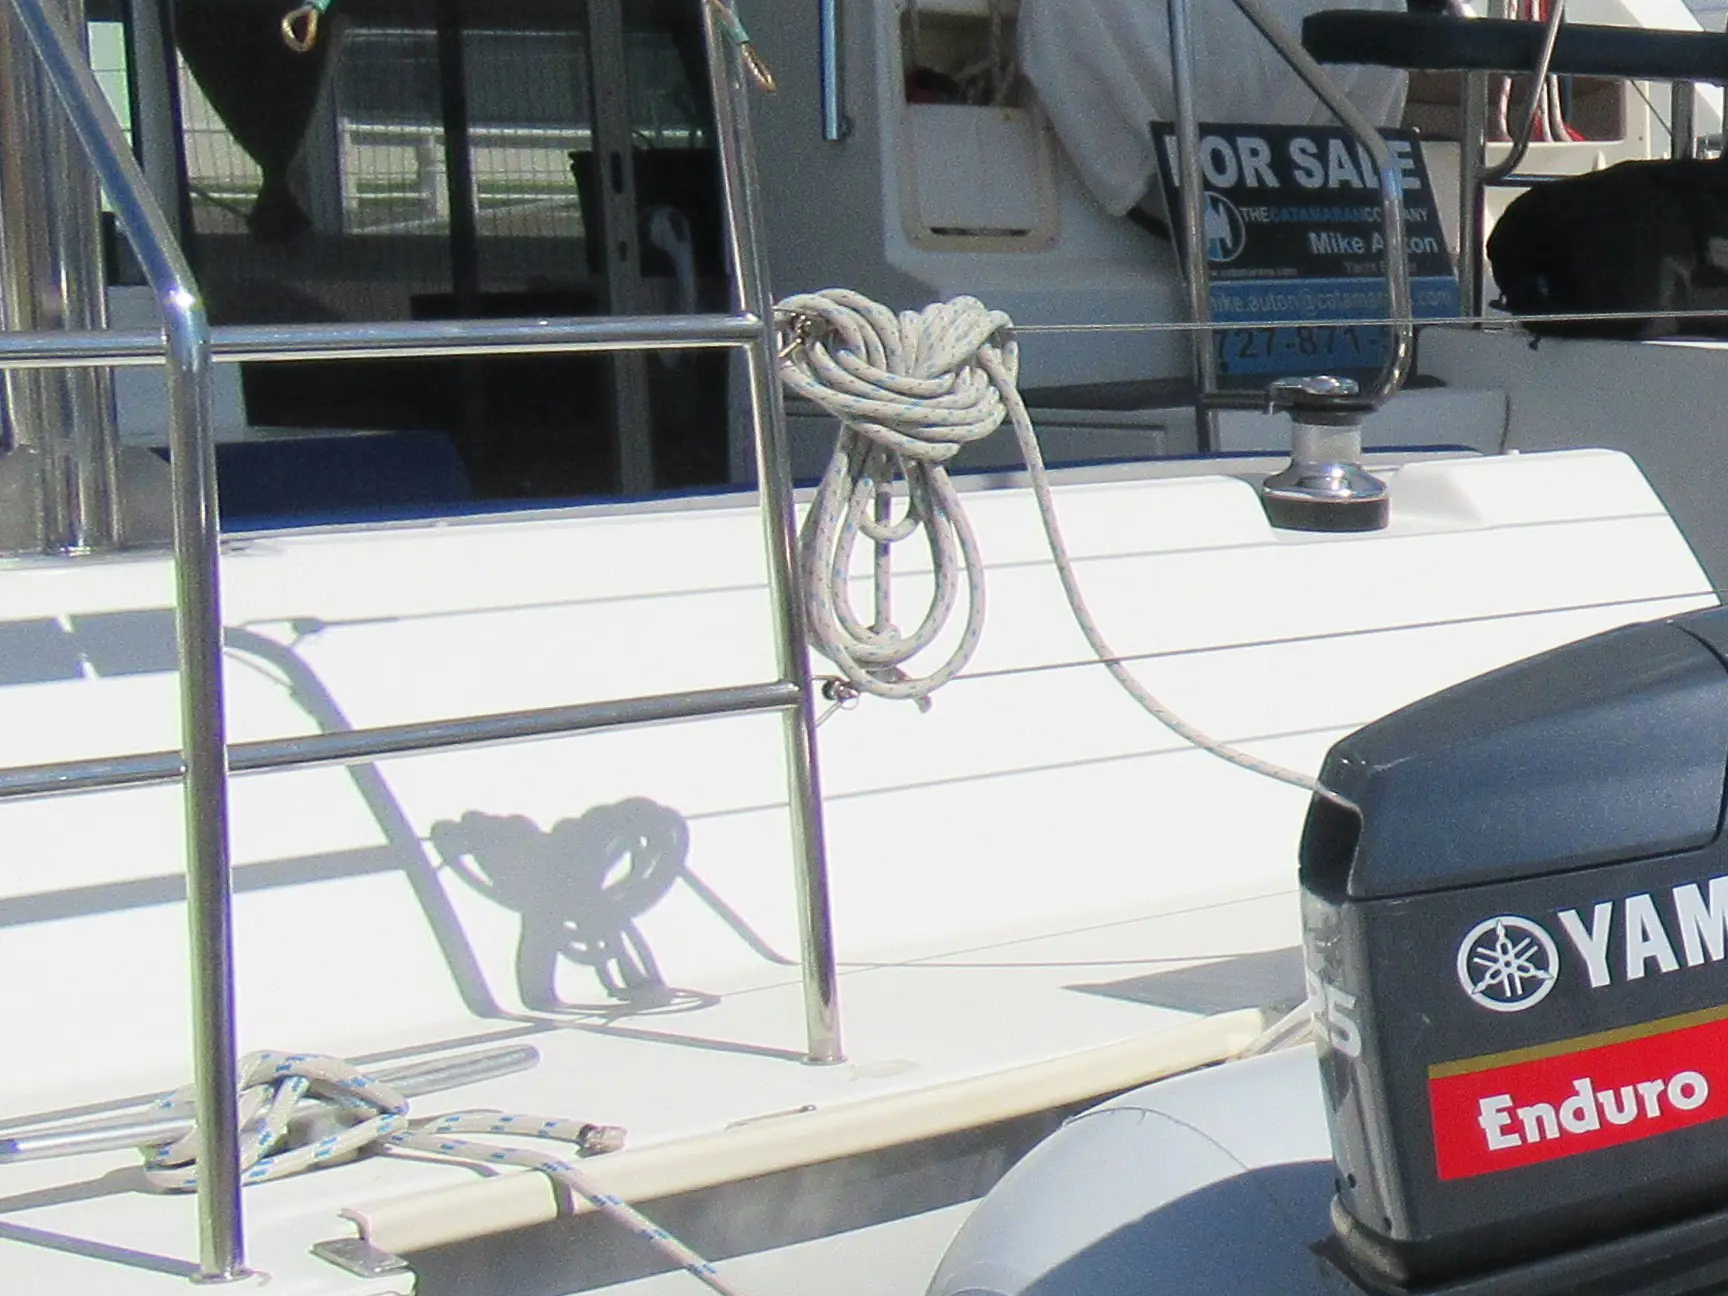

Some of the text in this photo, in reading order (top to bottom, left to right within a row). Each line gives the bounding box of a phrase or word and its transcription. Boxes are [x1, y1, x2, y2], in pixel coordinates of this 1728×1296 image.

[1287, 137, 1421, 190] SALE
[1308, 231, 1439, 254] Mike Aon
[1478, 1070, 1709, 1151] Enduro
